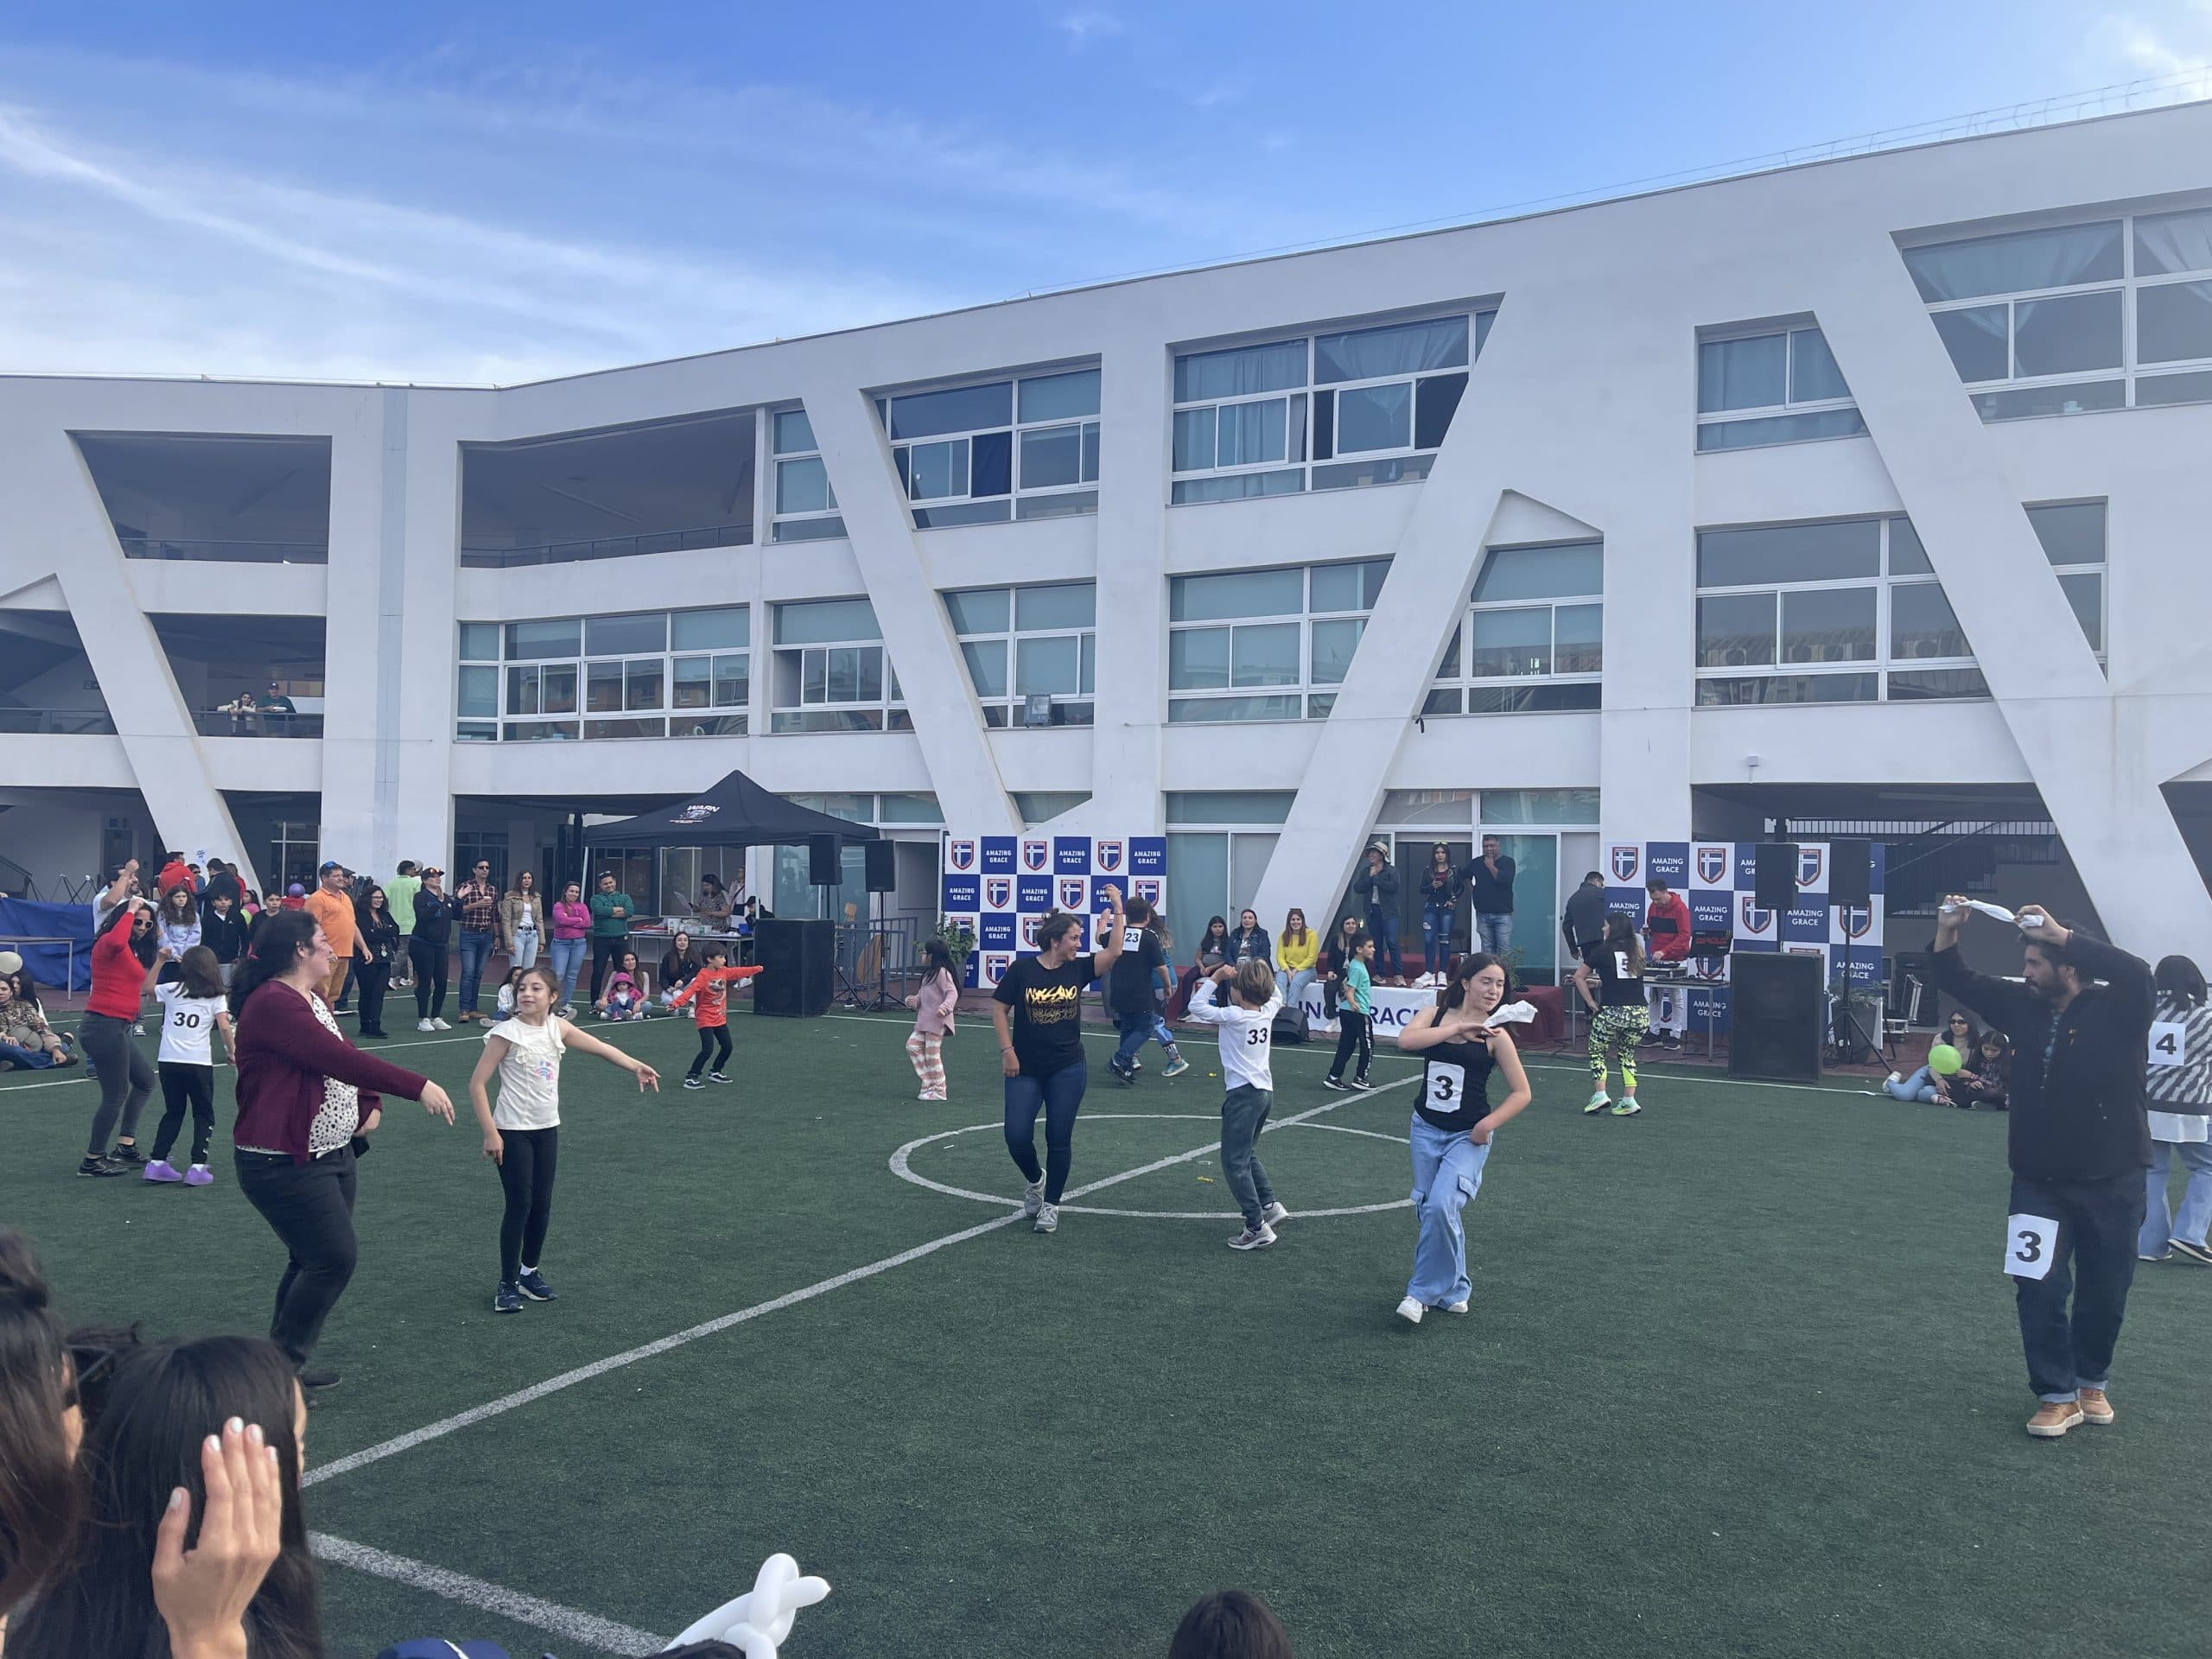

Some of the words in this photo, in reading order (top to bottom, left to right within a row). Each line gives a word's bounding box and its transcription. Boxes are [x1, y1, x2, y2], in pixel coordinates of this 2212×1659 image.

[1650, 856, 1685, 865] AMAZING
[1694, 906, 1728, 914] AMAZING
[1787, 909, 1824, 918] AMAZING
[1698, 913, 1724, 922] GRACE
[1791, 918, 1819, 926] GRACE
[1125, 932, 1139, 943] 23
[1693, 1000, 1727, 1009] AMAING
[174, 1013, 199, 1027] 30
[1369, 1006, 1420, 1027] RAC
[1247, 1027, 1269, 1045] 33
[2156, 1033, 2177, 1055] 4
[1434, 1076, 1452, 1100] 3
[2016, 1231, 2041, 1262] 3
